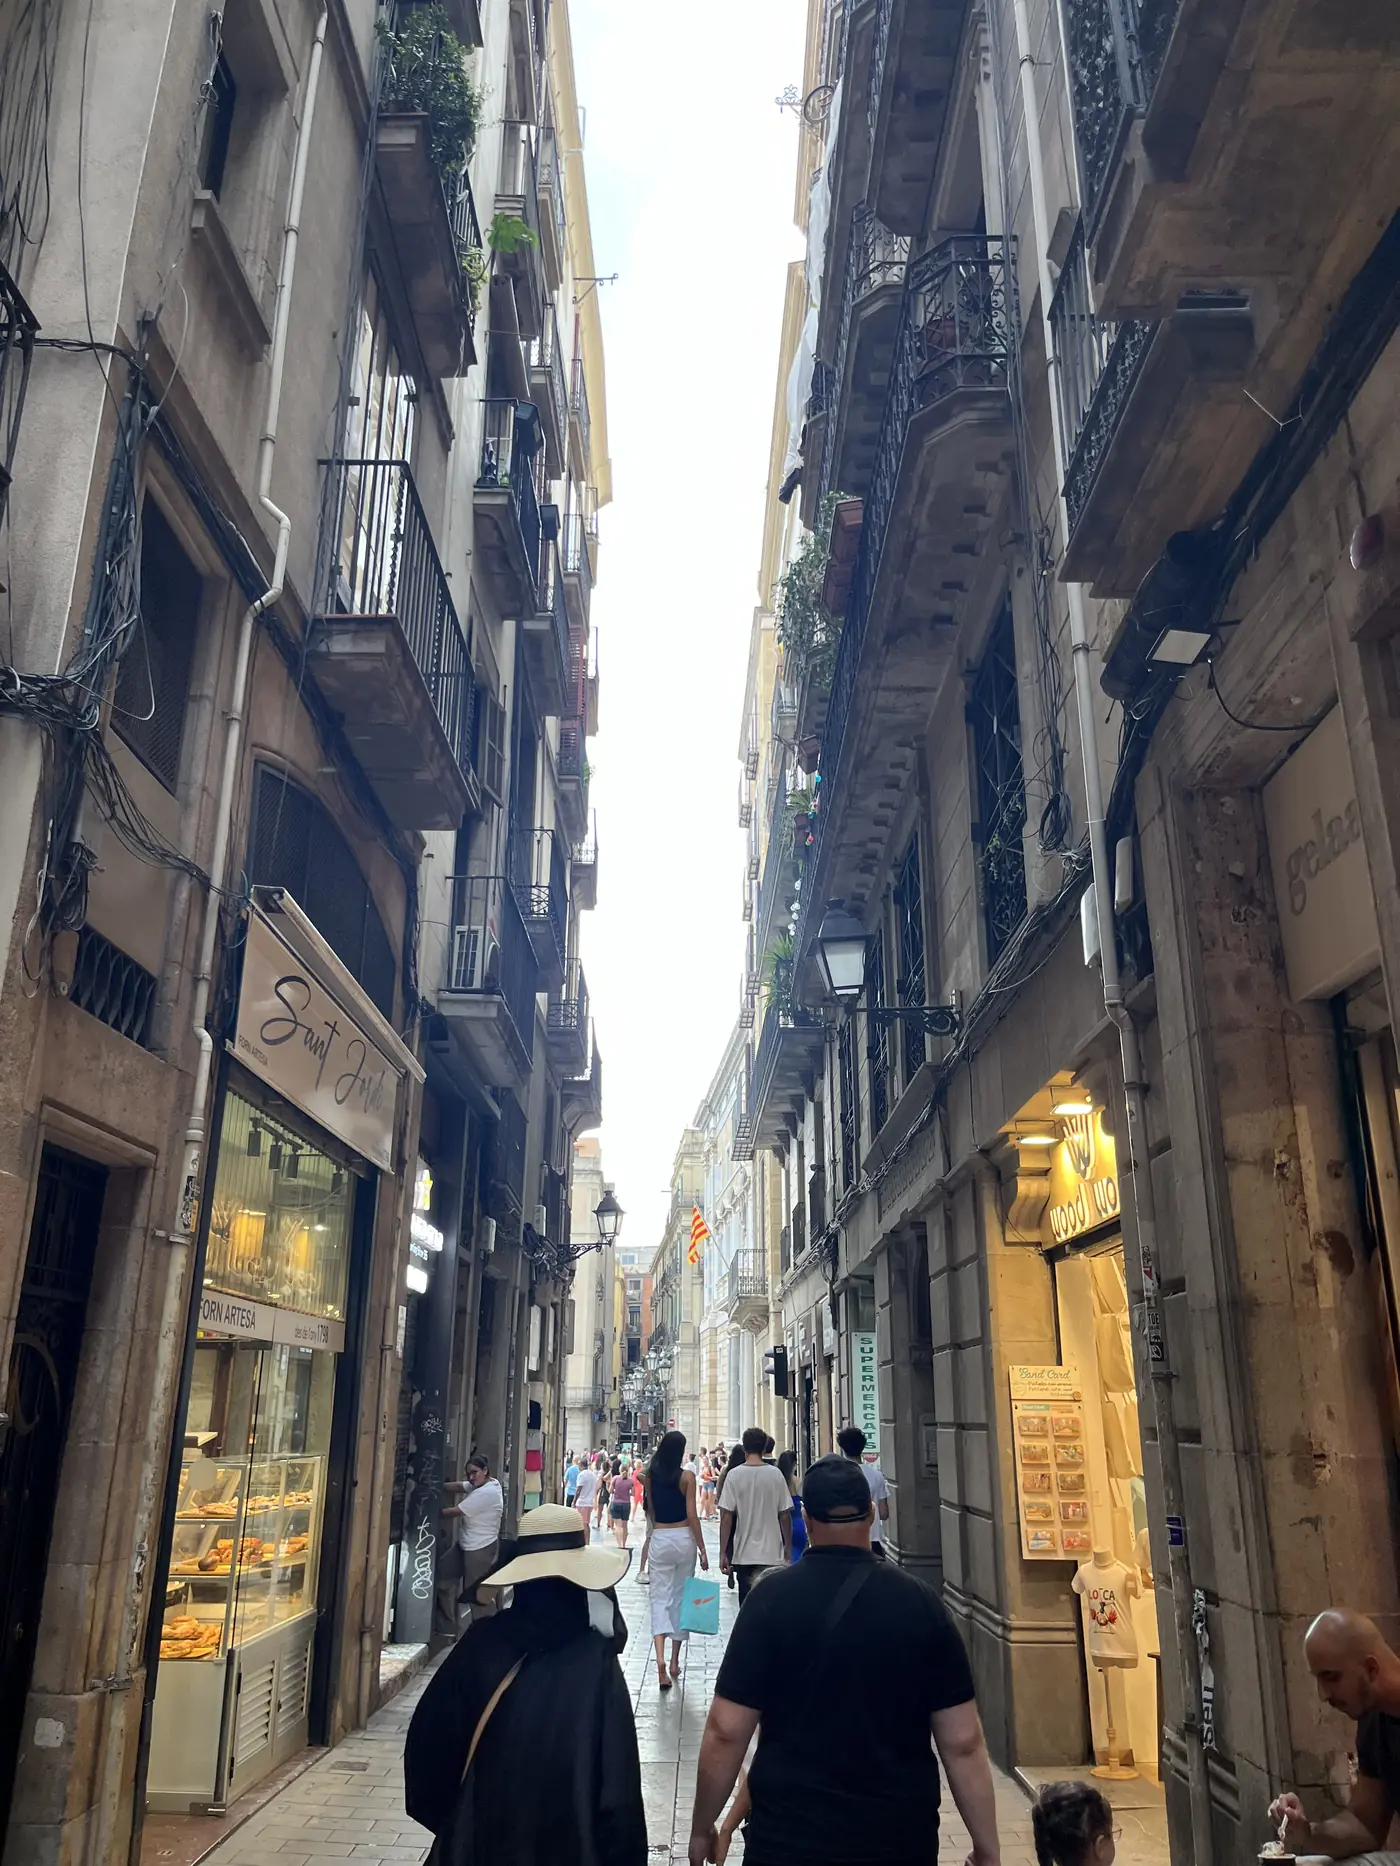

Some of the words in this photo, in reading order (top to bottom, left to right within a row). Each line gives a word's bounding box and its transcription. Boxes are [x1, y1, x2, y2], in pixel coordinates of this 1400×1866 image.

[260, 975, 340, 1092] Sant
[1049, 1182, 1089, 1241] wood
[860, 1337, 877, 1450] SUPERMERCATS
[1047, 1370, 1070, 1379] Card
